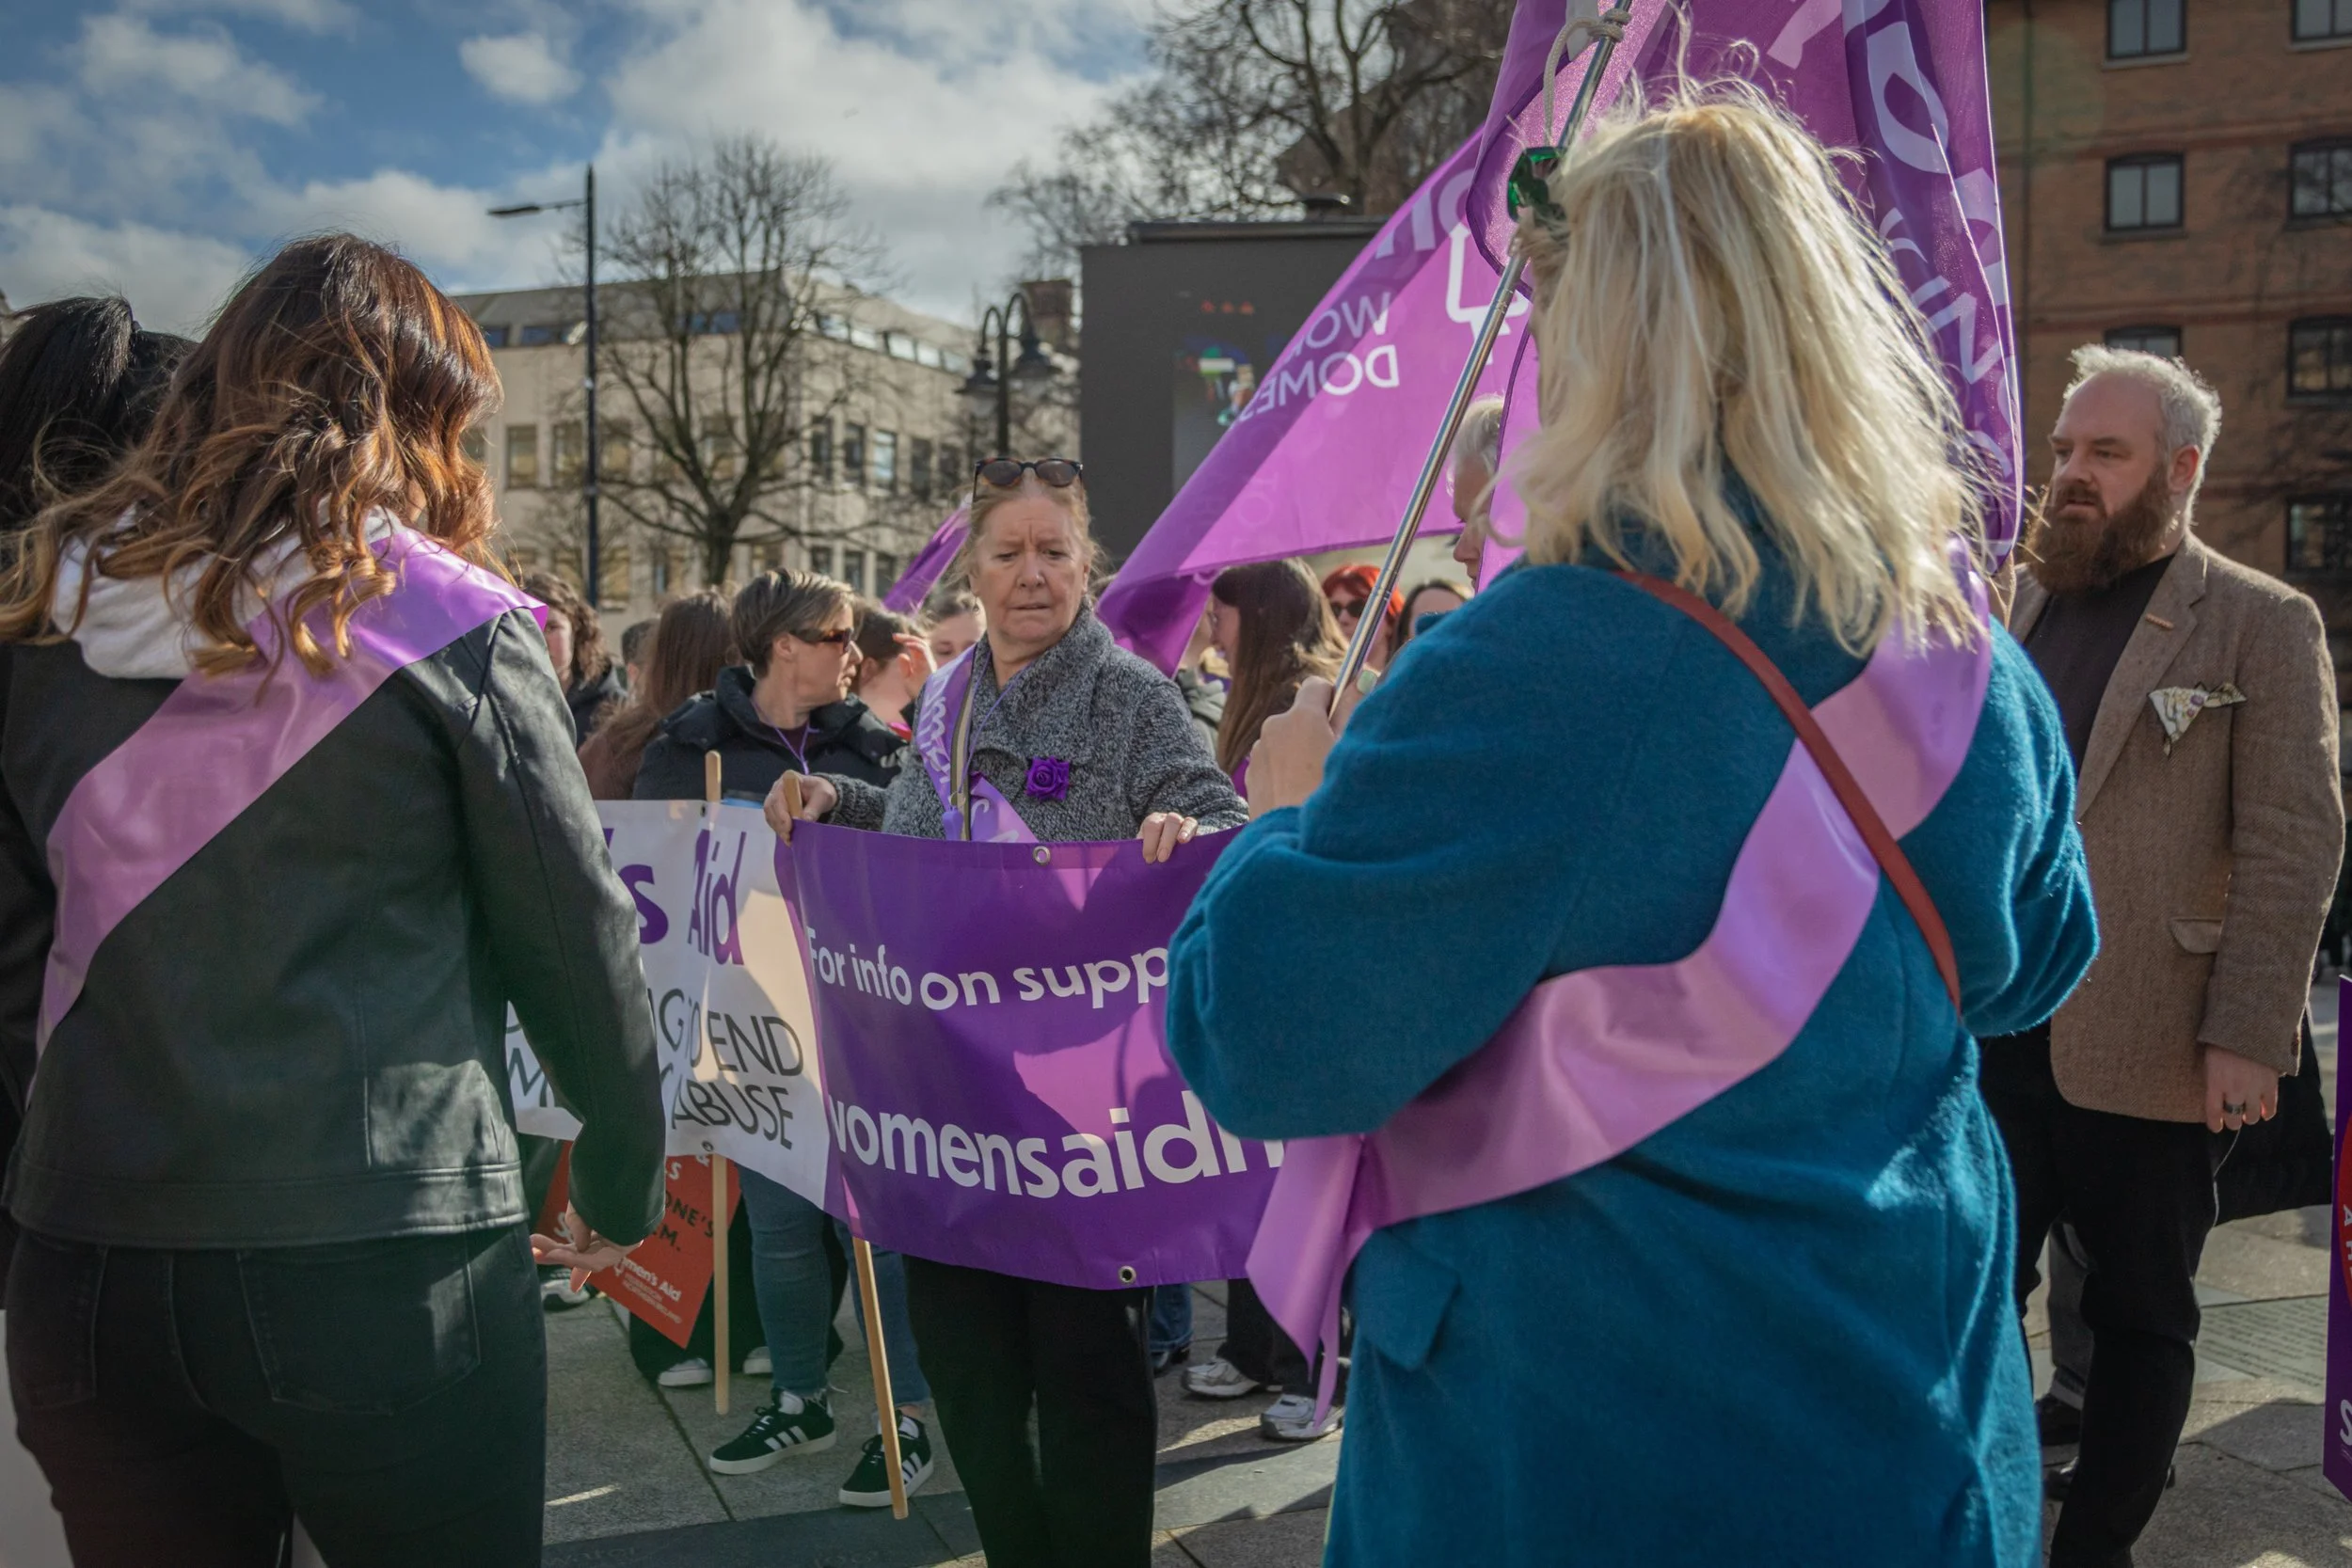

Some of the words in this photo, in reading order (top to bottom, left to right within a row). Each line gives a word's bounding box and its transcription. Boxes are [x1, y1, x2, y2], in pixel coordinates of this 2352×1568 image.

[688, 829, 746, 965] Aid
[850, 943, 913, 1006] info
[920, 969, 1001, 1010] on
[707, 1010, 803, 1077] END
[672, 1074, 794, 1150] ABUSE
